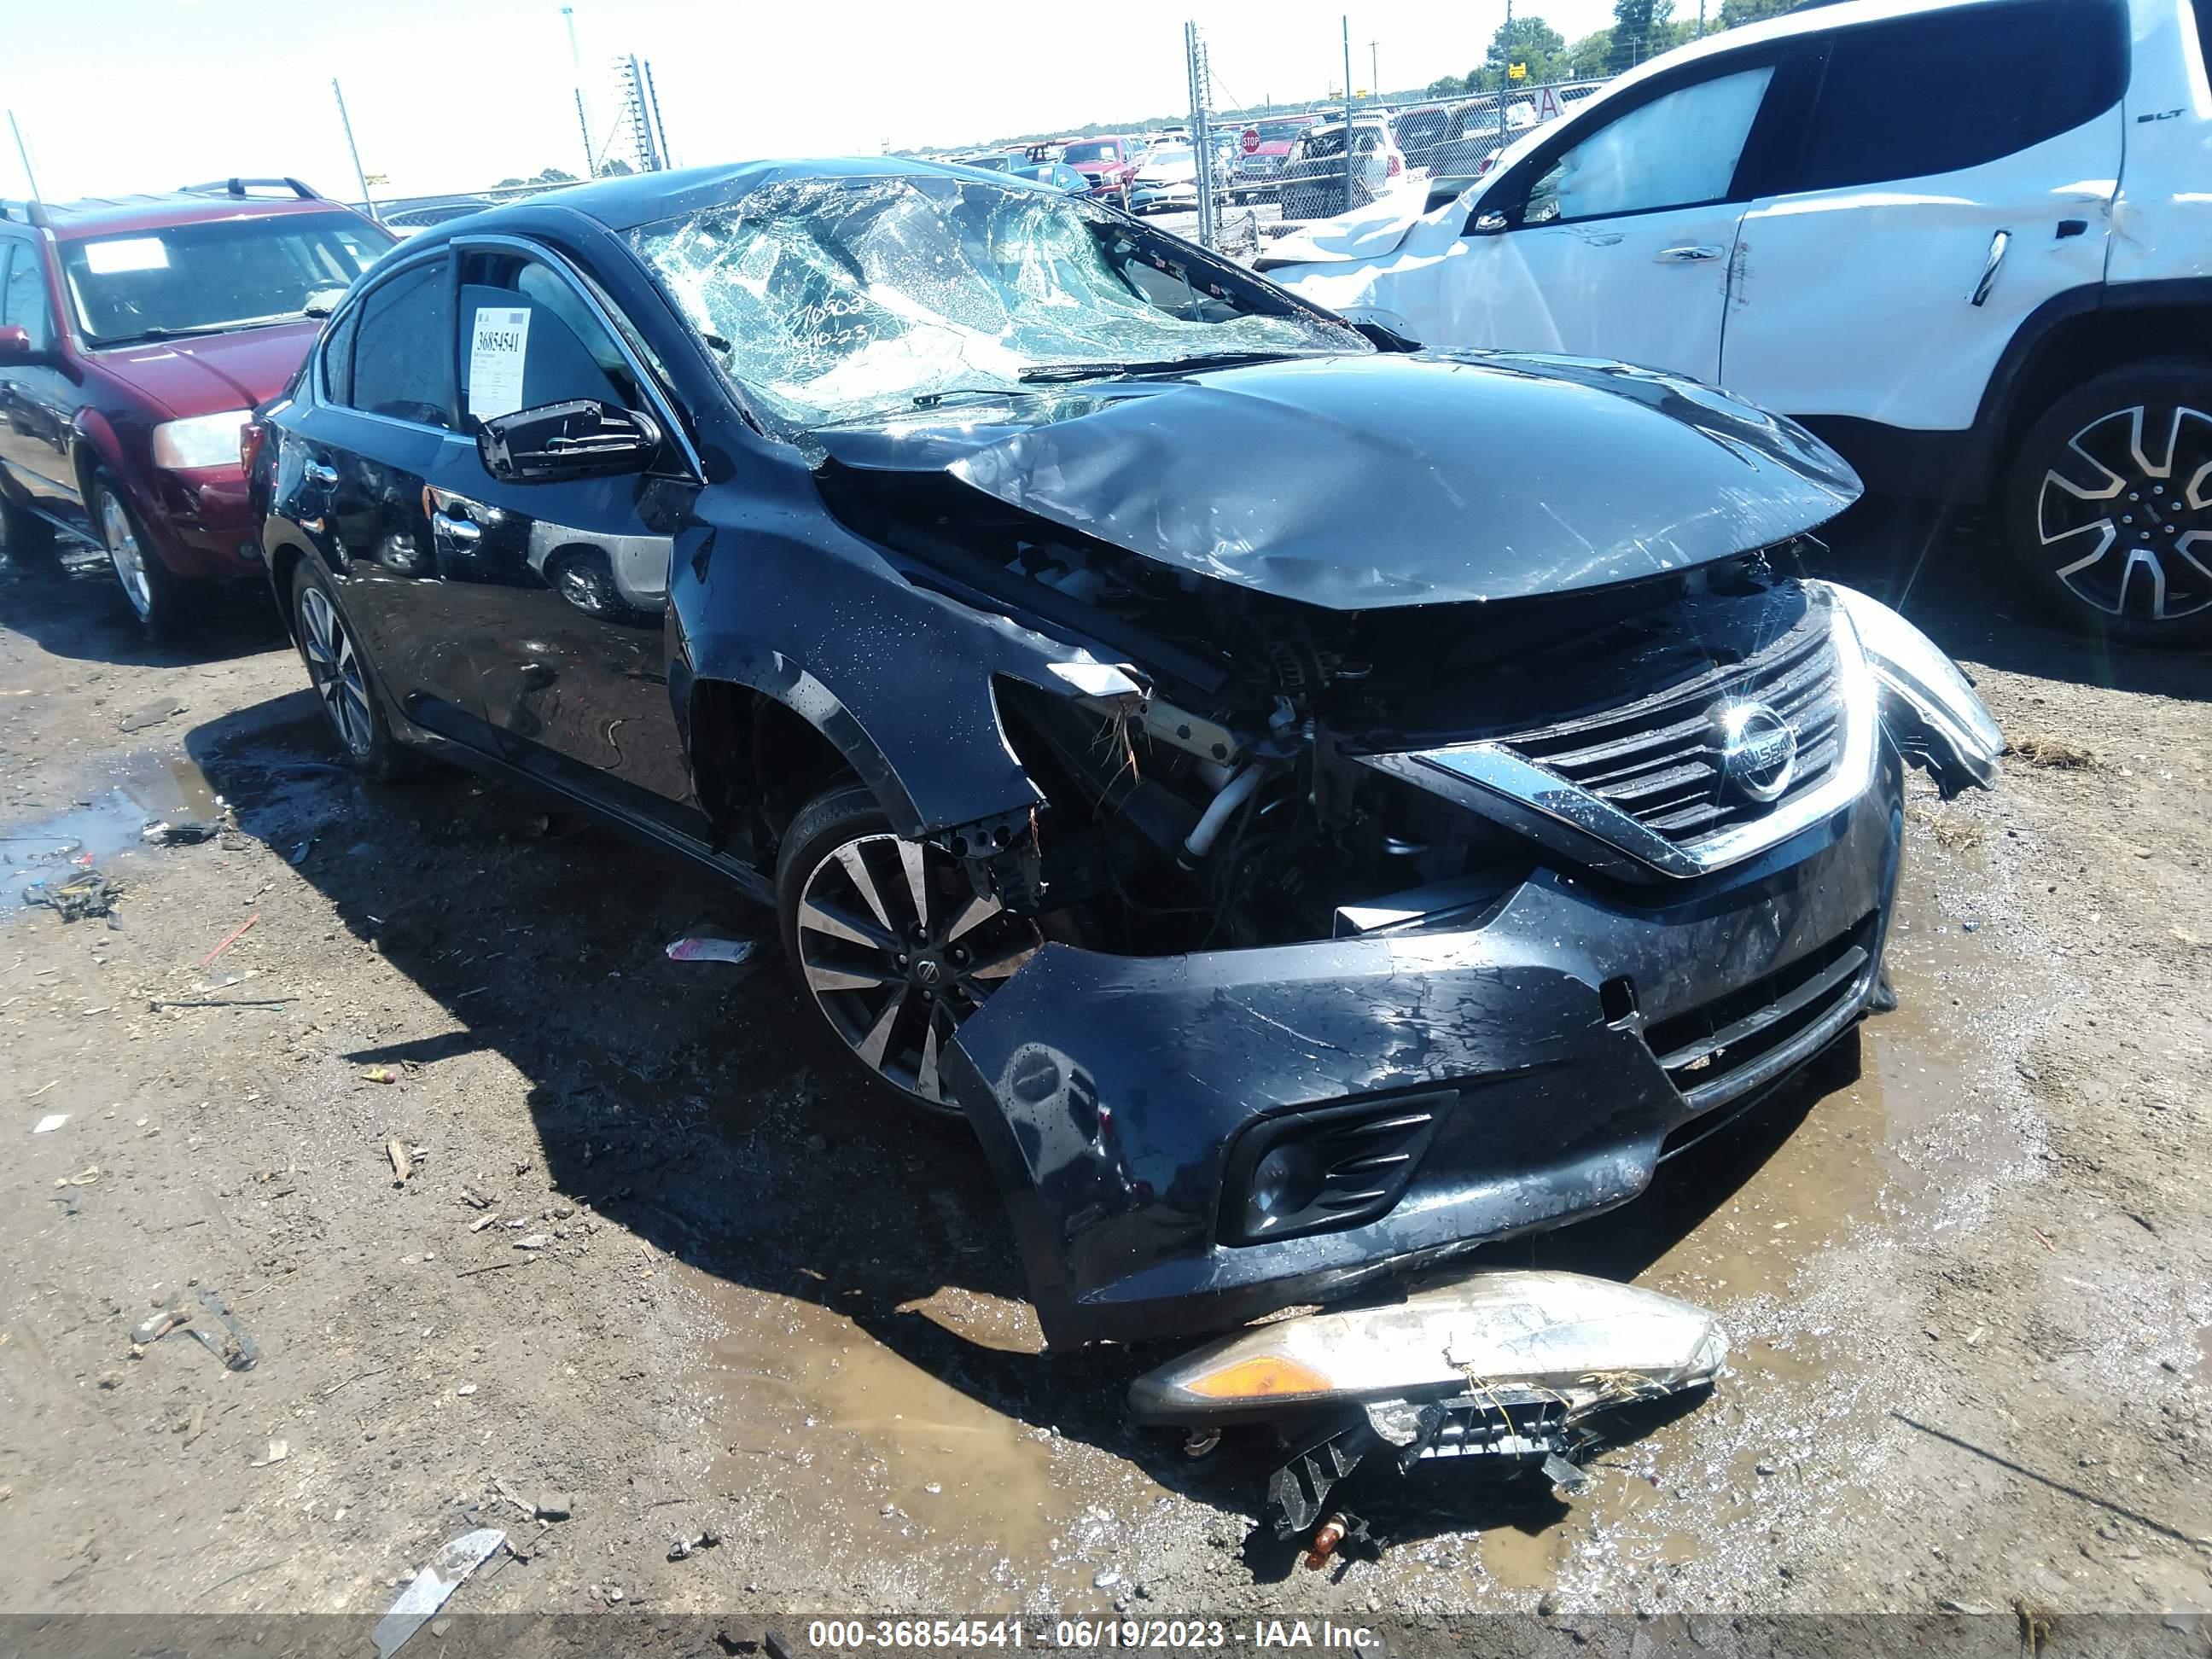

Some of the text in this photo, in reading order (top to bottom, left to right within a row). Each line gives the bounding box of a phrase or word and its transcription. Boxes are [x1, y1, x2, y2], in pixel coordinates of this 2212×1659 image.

[1540, 88, 1558, 119] A
[1243, 137, 1260, 147] STOP
[477, 331, 519, 352] 36854541
[1741, 736, 1795, 768] NISSAN
